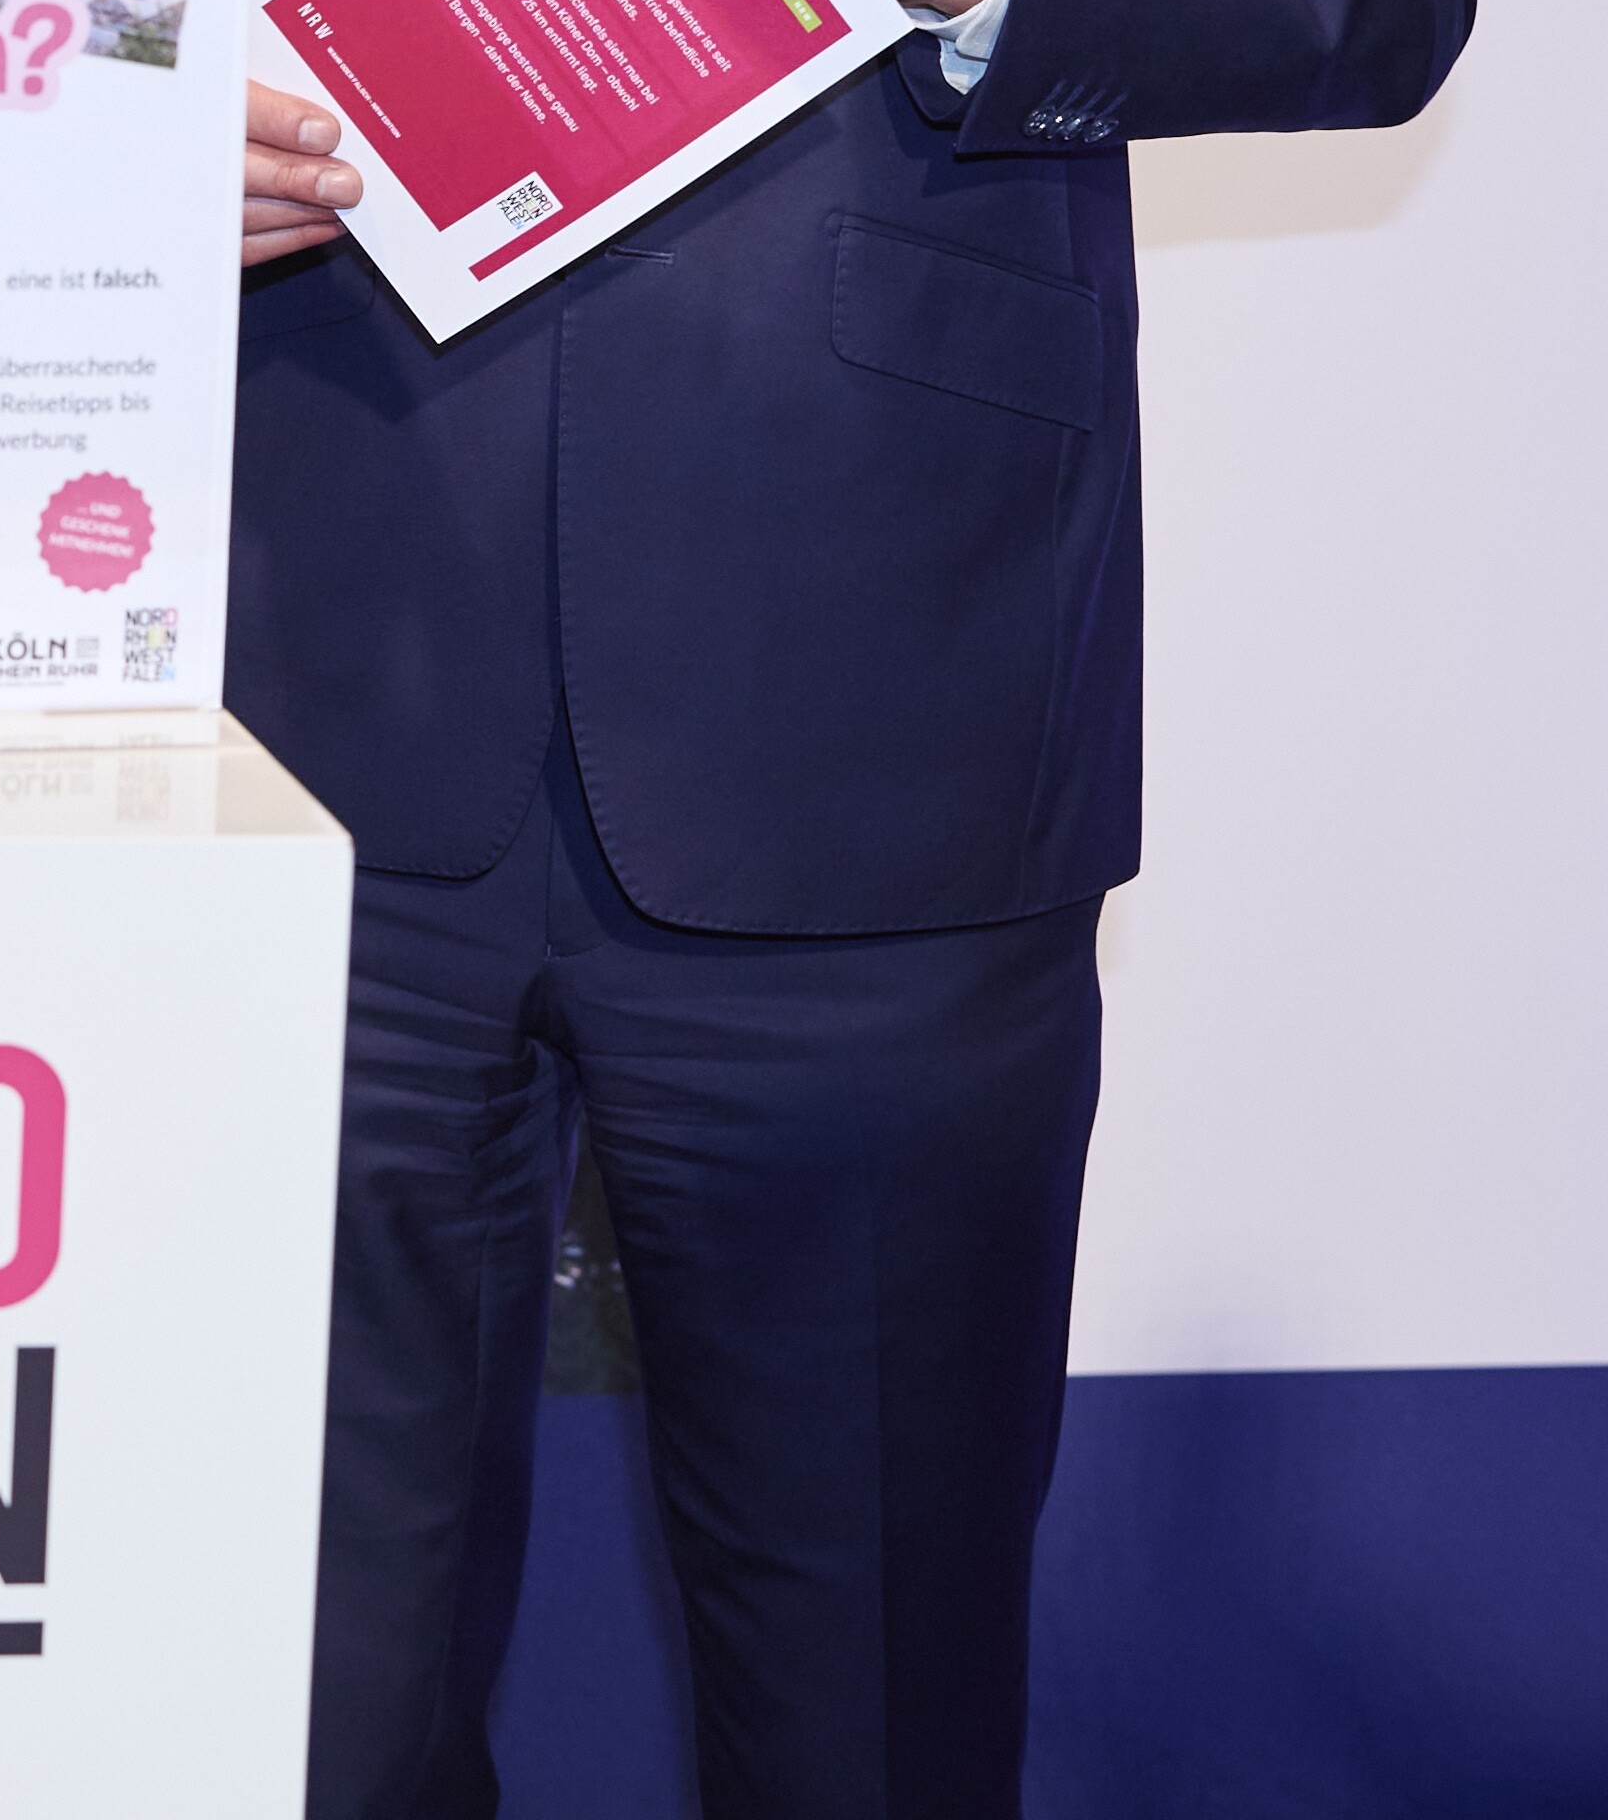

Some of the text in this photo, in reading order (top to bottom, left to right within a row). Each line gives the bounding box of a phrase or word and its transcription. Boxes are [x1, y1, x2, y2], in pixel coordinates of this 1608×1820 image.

[531, 8, 548, 28] km
[544, 26, 580, 68] entfernt
[575, 65, 597, 93] liegt.
[555, 7, 585, 41] Kölner
[580, 40, 602, 66] Dom
[606, 74, 639, 111] obwohl
[663, 20, 709, 77] befindliche
[700, 34, 716, 52] ist
[711, 50, 731, 72] seit
[483, 45, 510, 73] daher
[506, 73, 523, 91] der
[519, 89, 545, 124] Name.
[507, 42, 541, 83] besteht
[537, 82, 555, 101] aus
[549, 100, 578, 132] genau
[603, 39, 628, 66] sieht
[623, 64, 644, 88] man
[640, 85, 659, 104] bei
[505, 192, 533, 225] WEST
[524, 179, 554, 213] NORD
[495, 197, 525, 231] FALEN
[6, 270, 53, 290] eine
[60, 270, 85, 290] ist
[93, 268, 164, 289] falsch.
[0, 393, 113, 416] Reisetipps
[120, 392, 151, 412] bis
[126, 608, 177, 626] NORD
[47, 663, 98, 677] RUHR
[124, 647, 174, 663] WEST
